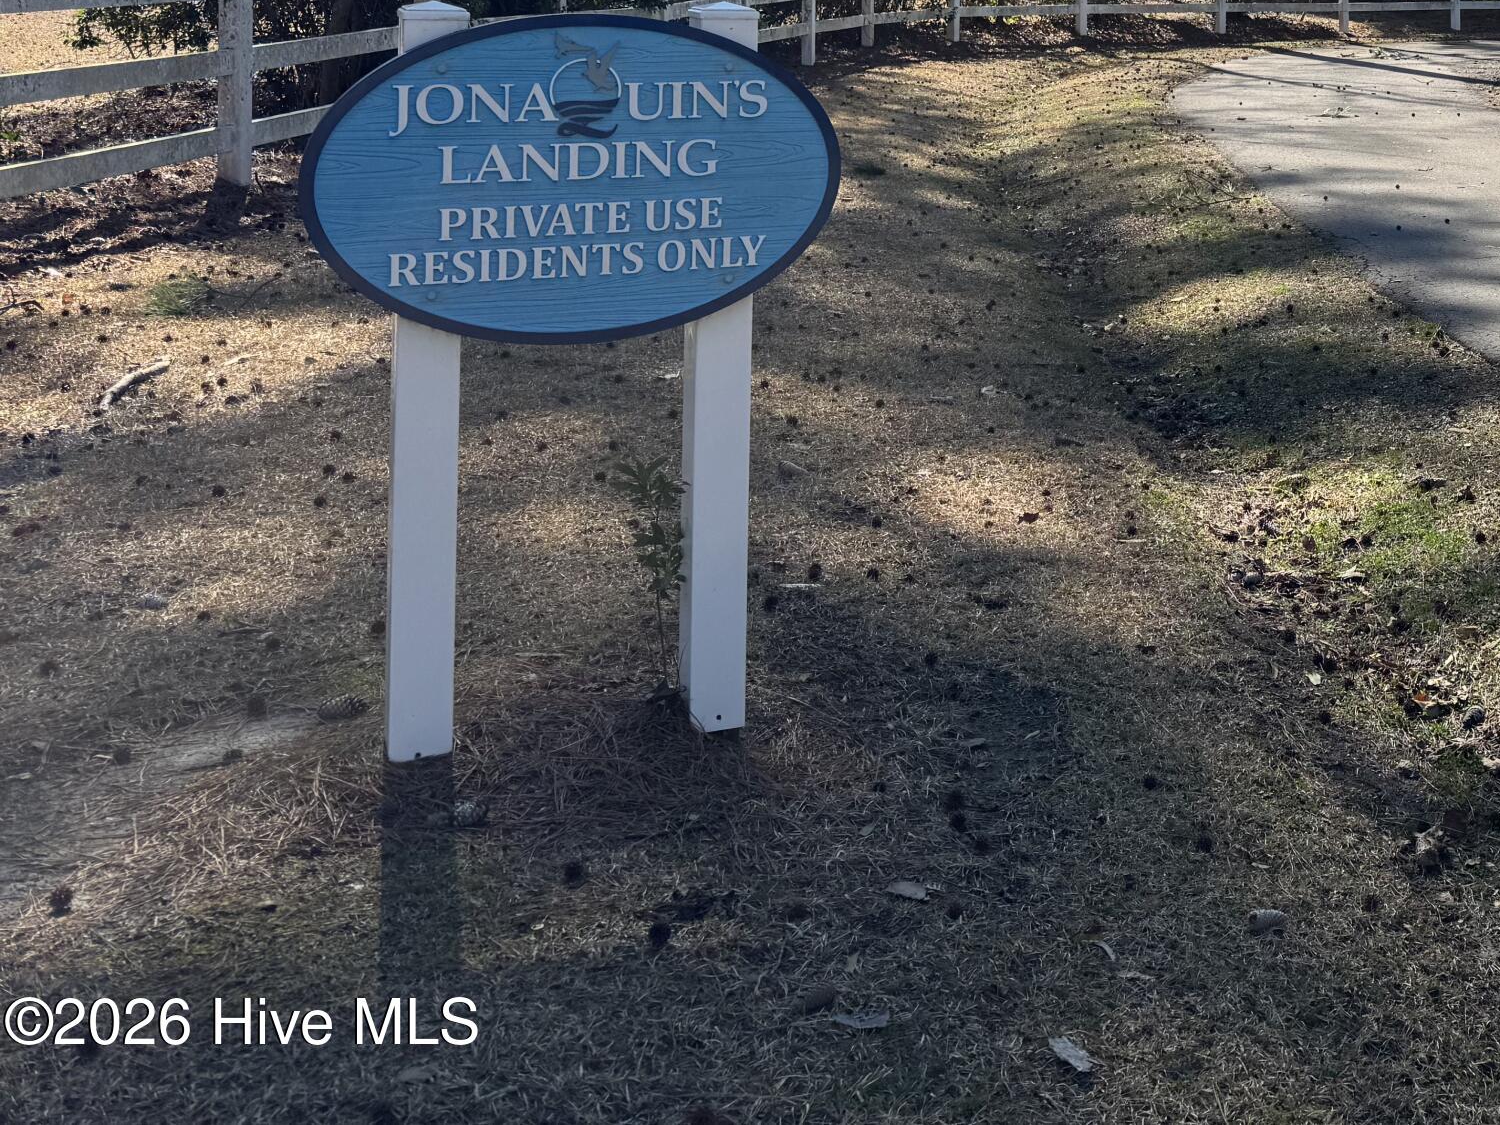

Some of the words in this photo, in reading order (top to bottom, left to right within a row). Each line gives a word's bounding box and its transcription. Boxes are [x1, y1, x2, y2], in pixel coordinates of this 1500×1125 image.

[438, 138, 719, 185] LANDING
[438, 200, 632, 242] PRIVATE
[645, 196, 724, 232] USE
[387, 241, 645, 288] RESIDENTS
[657, 234, 768, 271] ONLY
